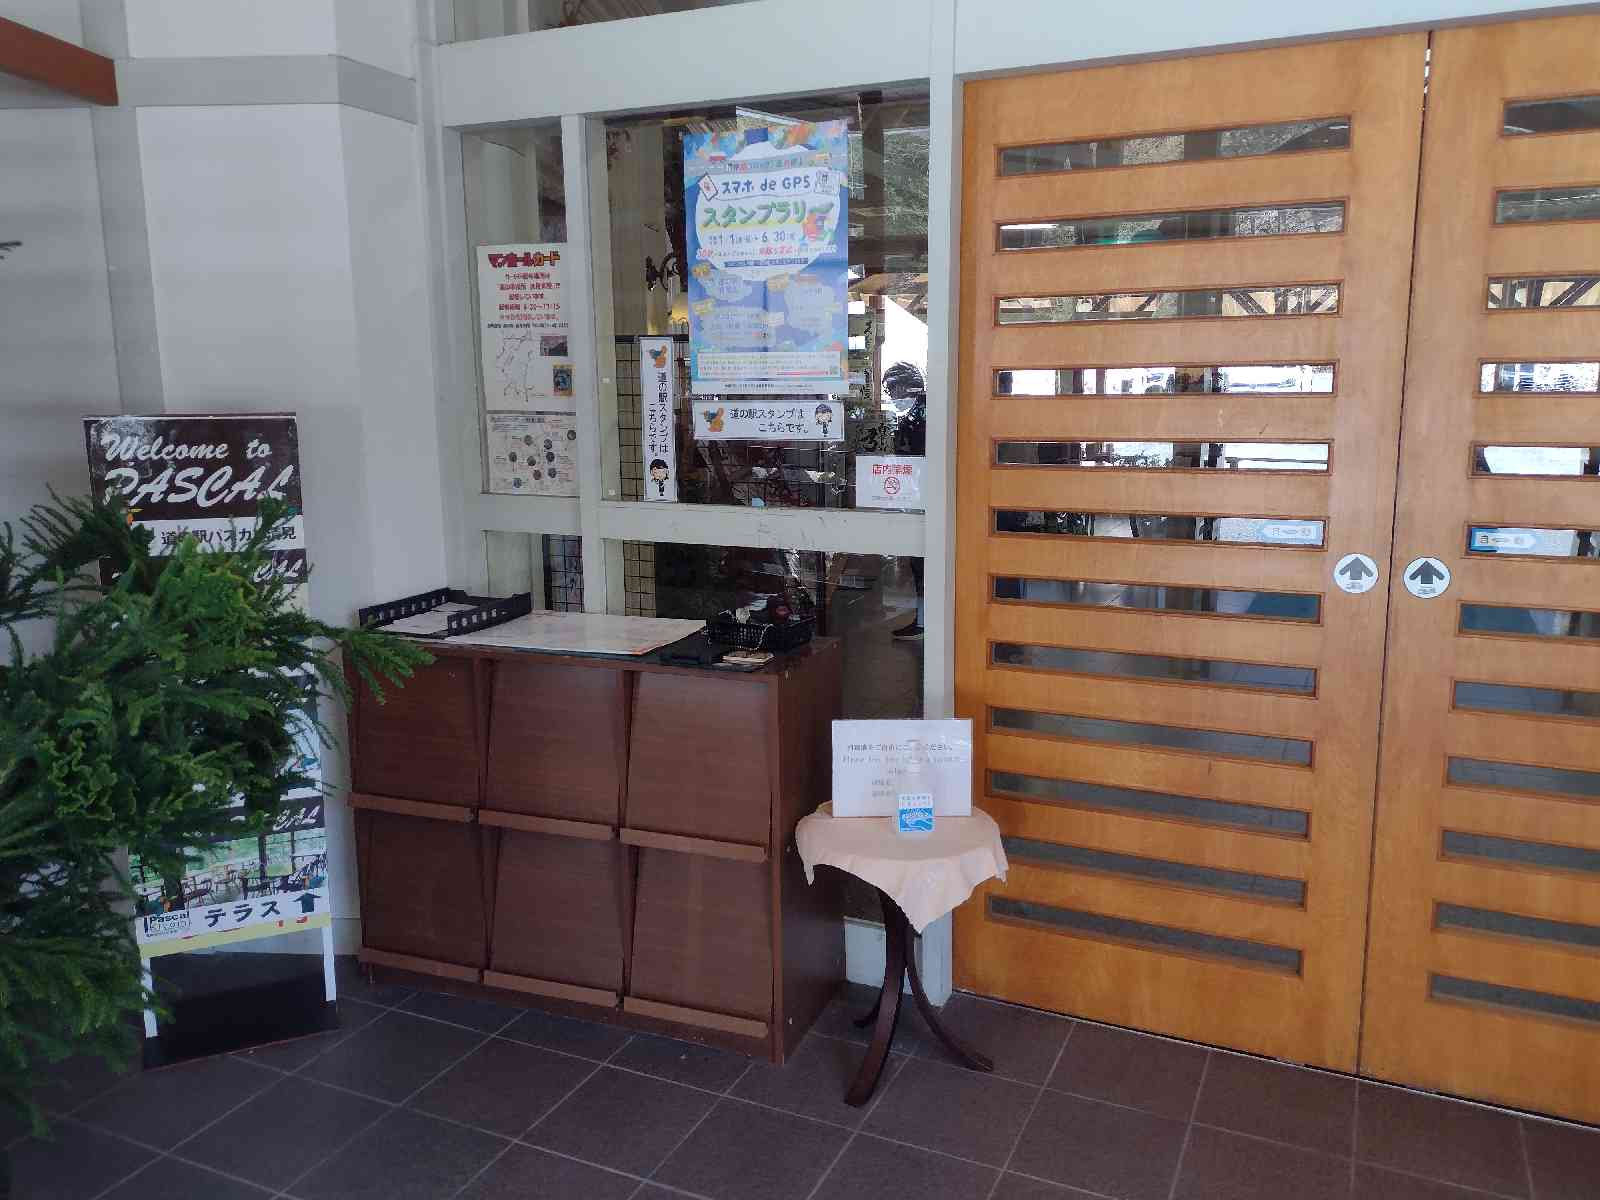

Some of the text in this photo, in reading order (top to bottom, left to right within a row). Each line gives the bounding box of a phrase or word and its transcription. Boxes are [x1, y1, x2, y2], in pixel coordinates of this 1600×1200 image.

[722, 176, 811, 194] スマホ de GPS
[703, 199, 836, 228] スタンプラリー
[656, 372, 669, 453] 道の駅スタンプは
[729, 407, 805, 420] 道の駅スタンプは
[648, 402, 658, 457] こちらです。
[758, 422, 809, 435] こちらです。
[100, 434, 273, 462] Welcome to
[103, 464, 294, 508] PASCAL
[150, 910, 190, 928] Pascal
[204, 900, 281, 928] テラス
